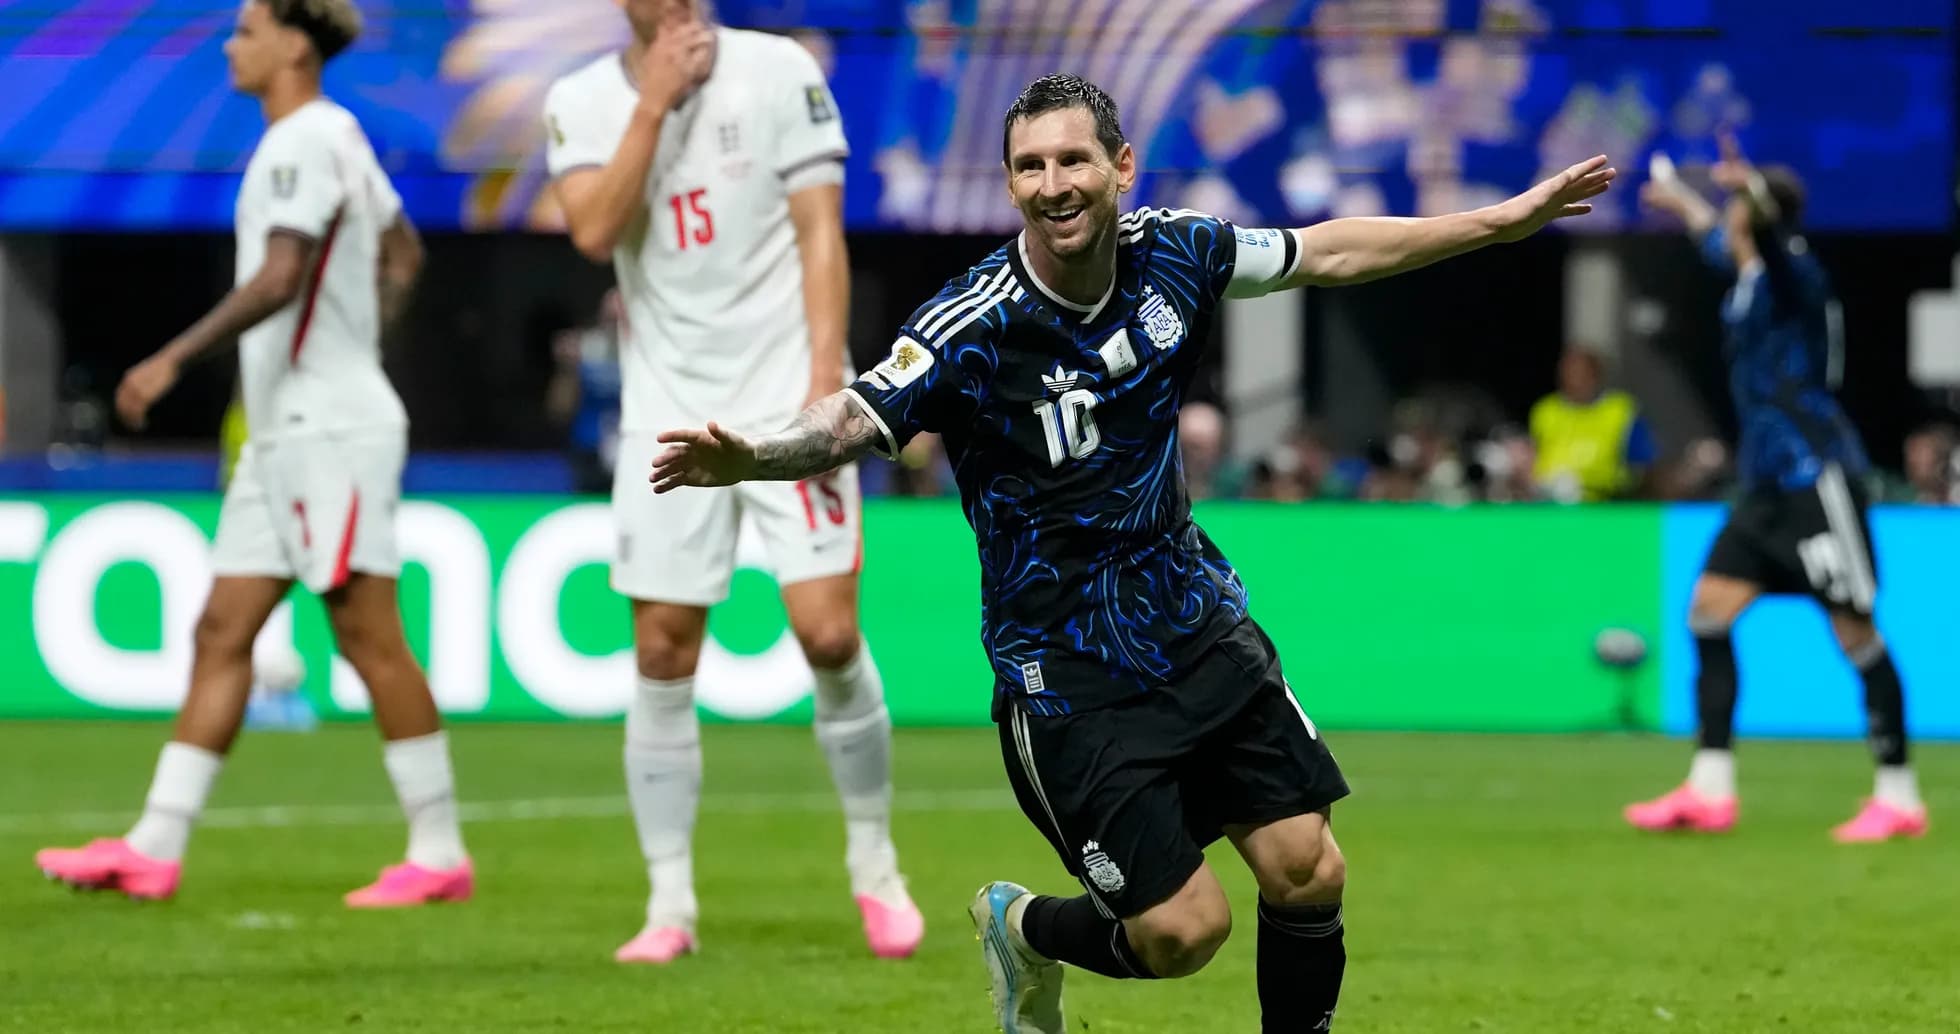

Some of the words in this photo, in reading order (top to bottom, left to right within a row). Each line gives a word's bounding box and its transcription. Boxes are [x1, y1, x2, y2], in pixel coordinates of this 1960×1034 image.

[669, 187, 714, 250] 15
[1031, 388, 1102, 468] 10
[795, 478, 846, 532] 15
